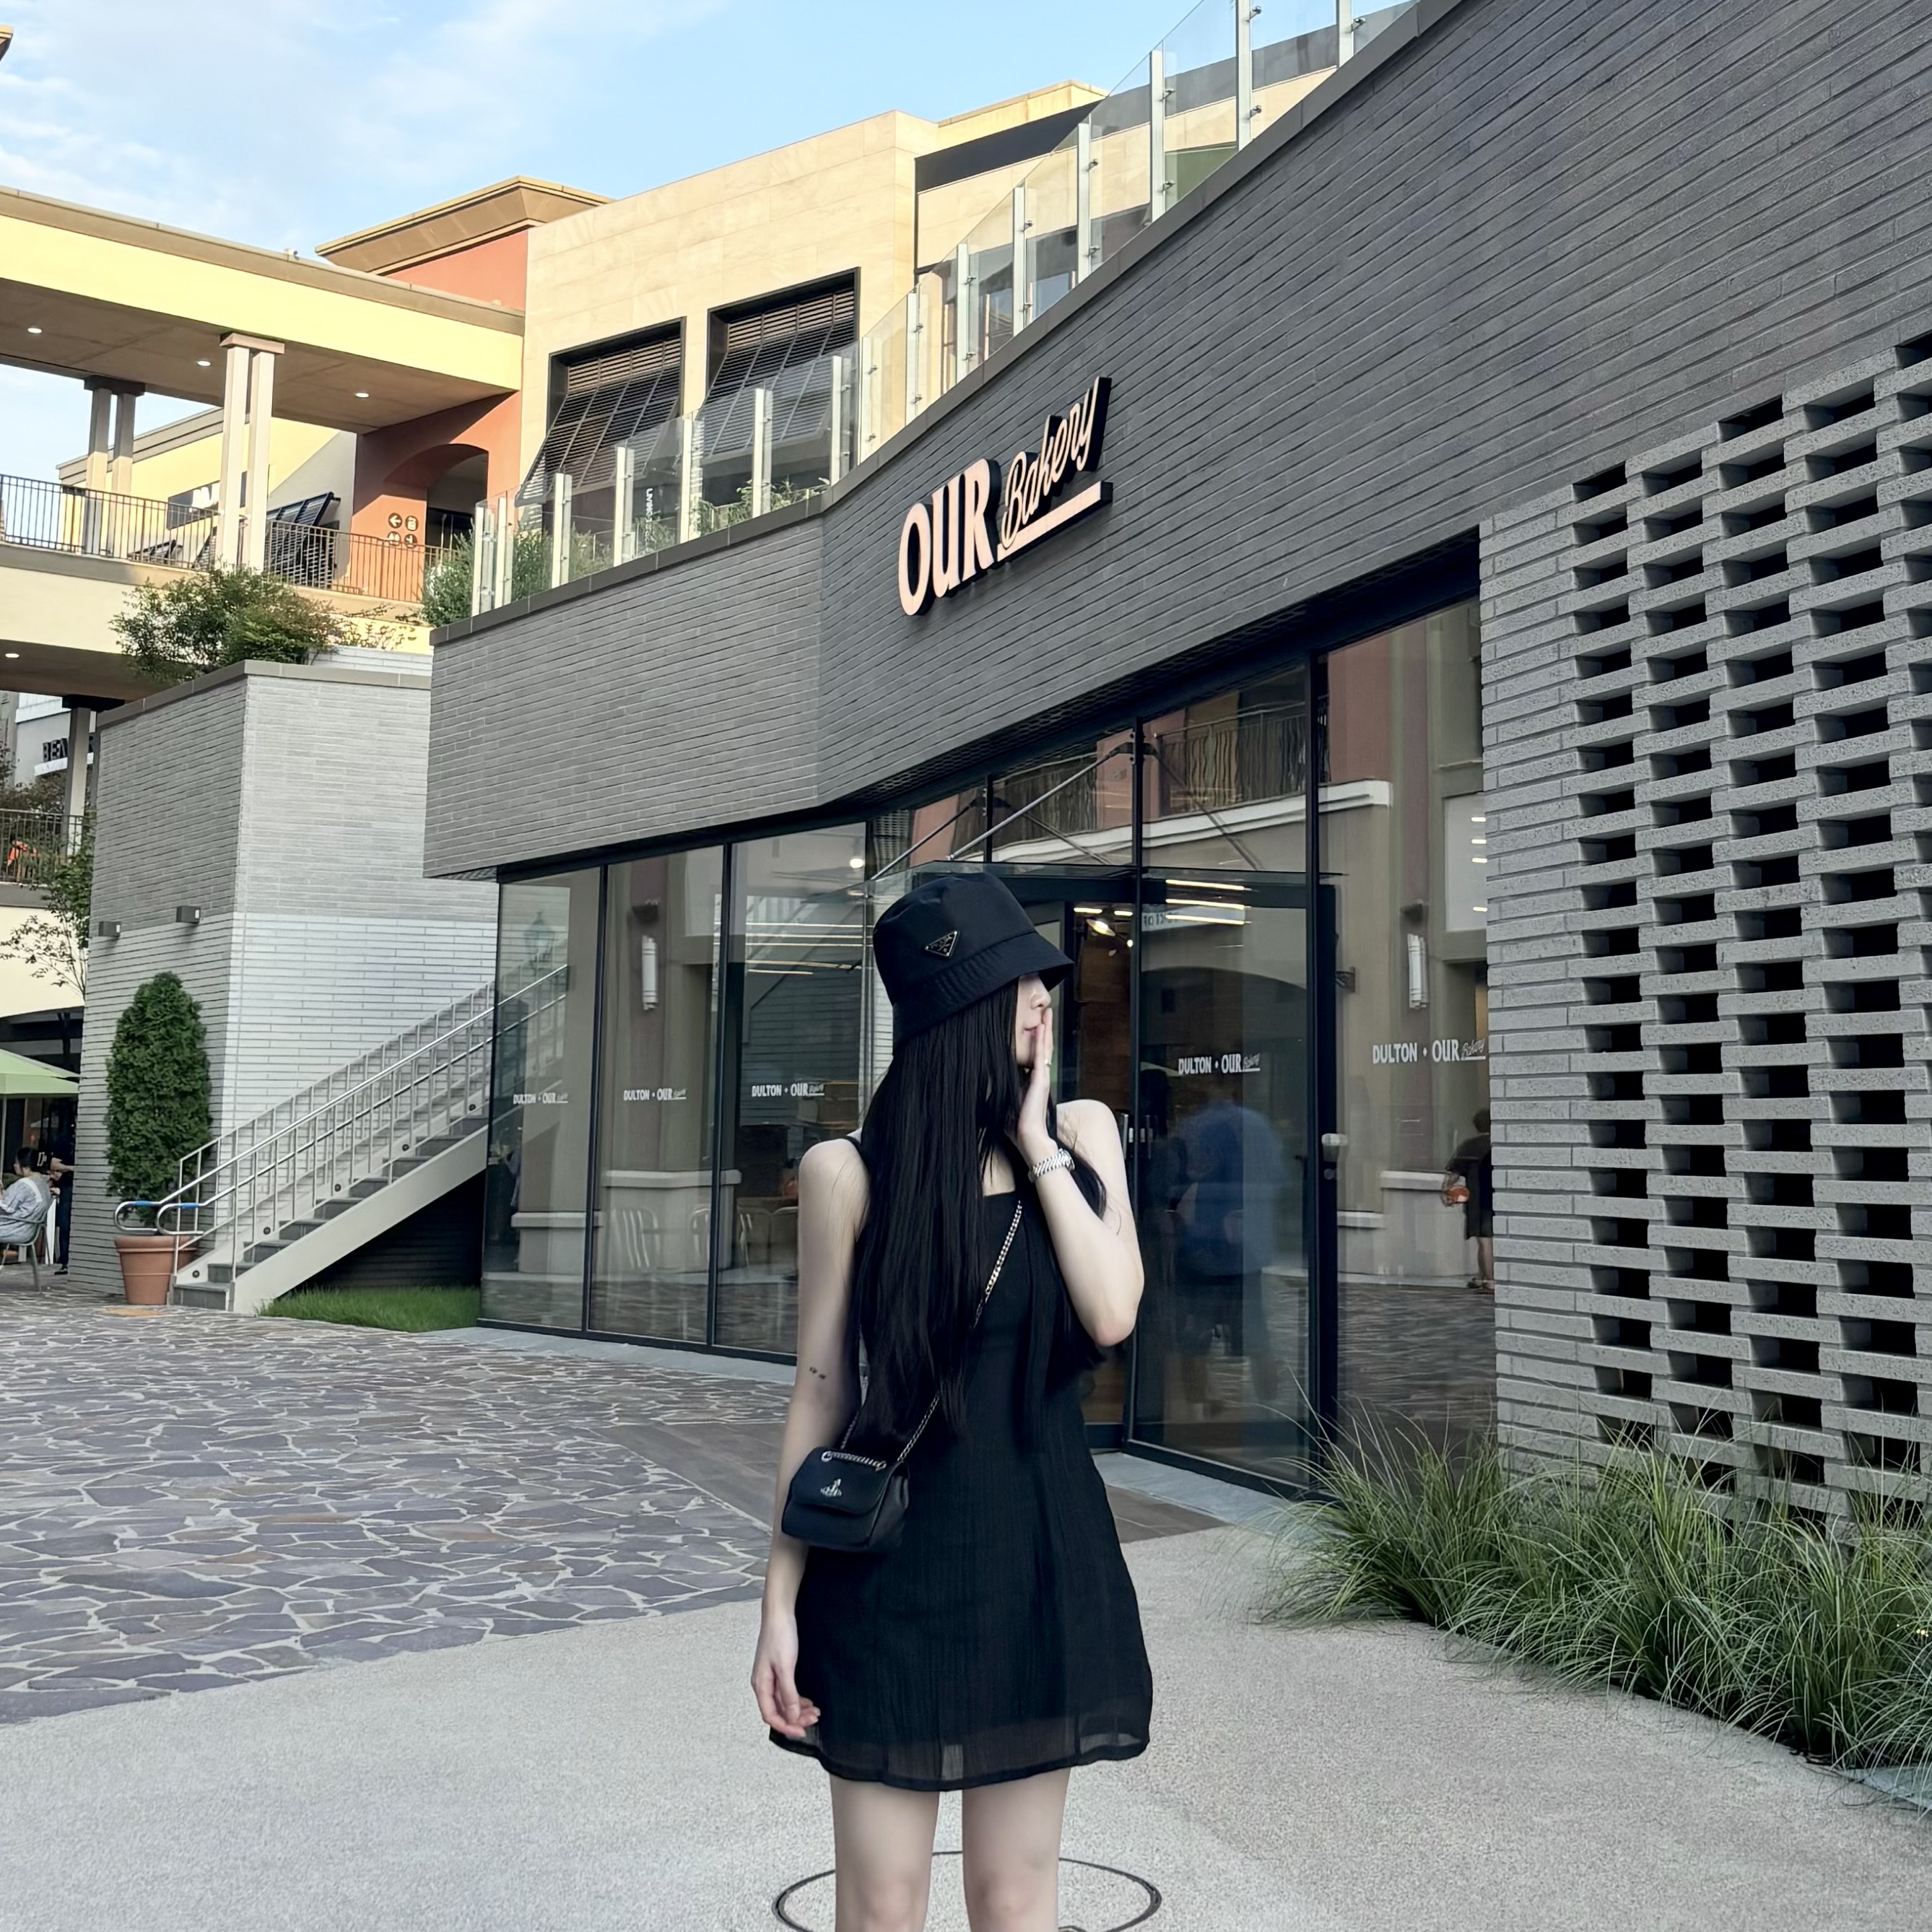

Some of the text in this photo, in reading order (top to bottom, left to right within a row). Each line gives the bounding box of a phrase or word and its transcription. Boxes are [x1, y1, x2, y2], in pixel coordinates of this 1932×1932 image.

[898, 376, 1106, 616] OUR Bakery
[1372, 1043, 1418, 1064] DULTON
[1432, 1039, 1461, 1062] OUR
[1178, 1056, 1211, 1074] DULTON
[1221, 1053, 1242, 1074] OUR
[656, 1088, 672, 1100] OUR
[752, 1084, 782, 1097] DULTON
[791, 1083, 809, 1096] OUR
